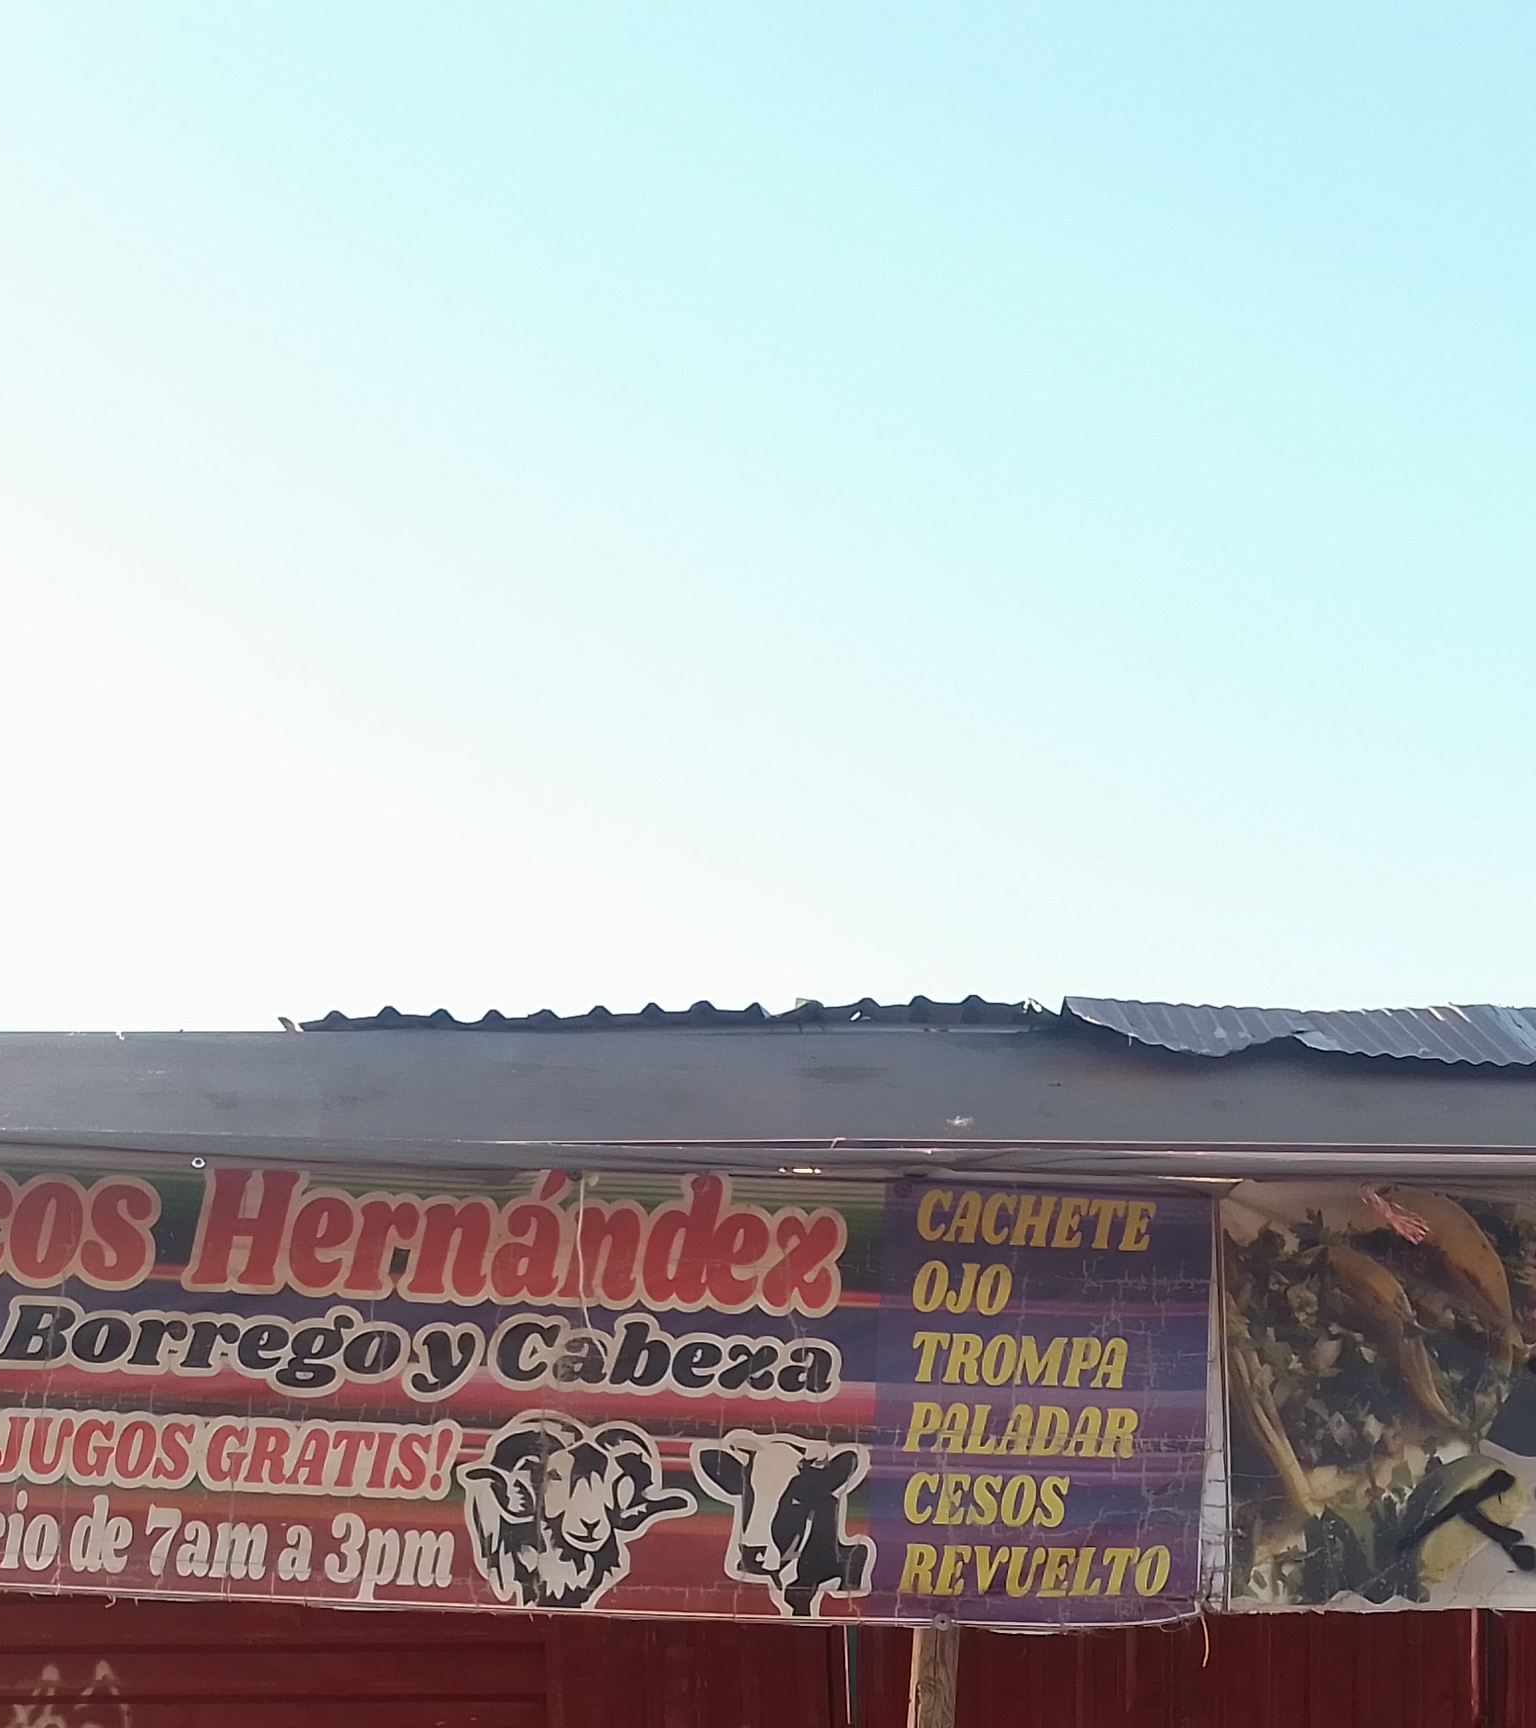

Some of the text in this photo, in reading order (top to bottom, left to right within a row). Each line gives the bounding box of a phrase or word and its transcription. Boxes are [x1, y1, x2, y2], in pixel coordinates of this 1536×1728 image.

[185, 1166, 841, 1311] Hernández
[916, 1188, 1158, 1253] CACHETE
[912, 1260, 1013, 1317] OJO
[409, 1327, 475, 1394] y
[496, 1318, 834, 1394] Cabeza
[912, 1330, 1129, 1390] TROMPA
[205, 1422, 456, 1493] GRATIS!
[904, 1401, 1140, 1459] PALADAR
[903, 1471, 1071, 1529] CESOS
[69, 1496, 129, 1573] de
[144, 1503, 267, 1582] 7am
[277, 1524, 314, 1582] a
[323, 1512, 454, 1601] 3pm
[899, 1543, 1171, 1599] REVUELTO
